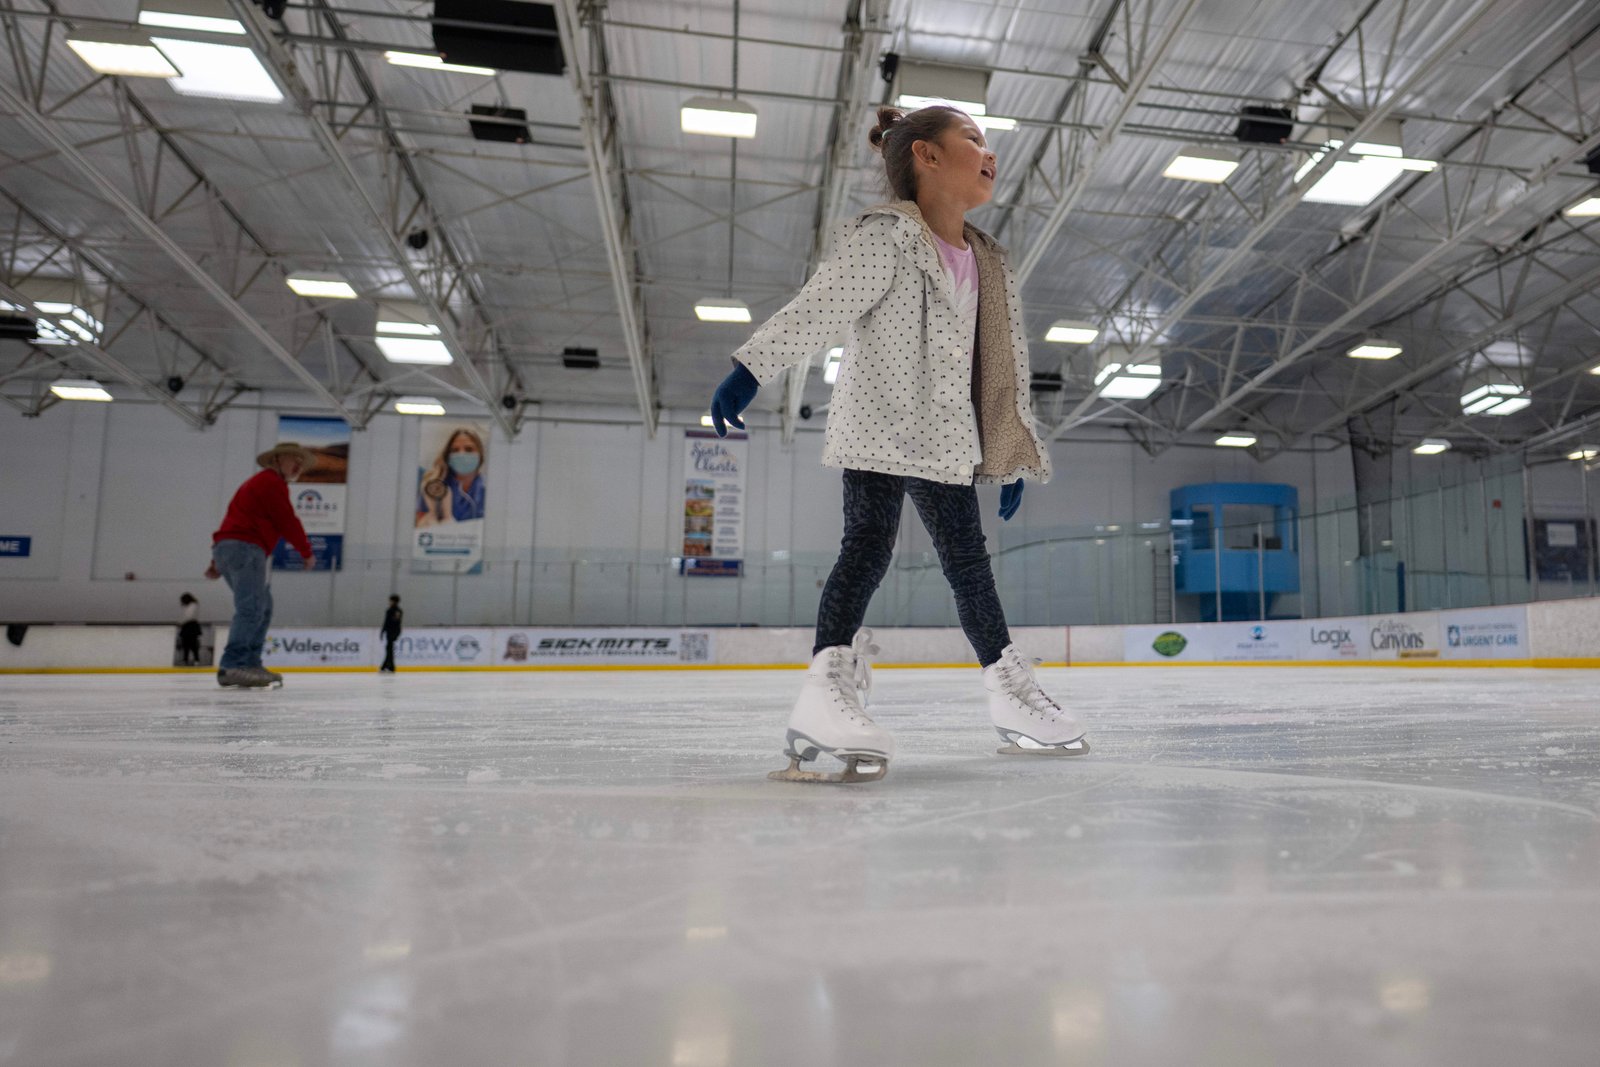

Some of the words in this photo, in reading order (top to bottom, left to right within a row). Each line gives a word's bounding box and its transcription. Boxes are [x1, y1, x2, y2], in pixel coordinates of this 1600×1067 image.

[282, 637, 360, 653] Valencia
[1311, 625, 1351, 649] Logix
[1371, 627, 1424, 655] Canyons
[1463, 635, 1493, 647] URGENT
[1496, 633, 1518, 646] CARE
